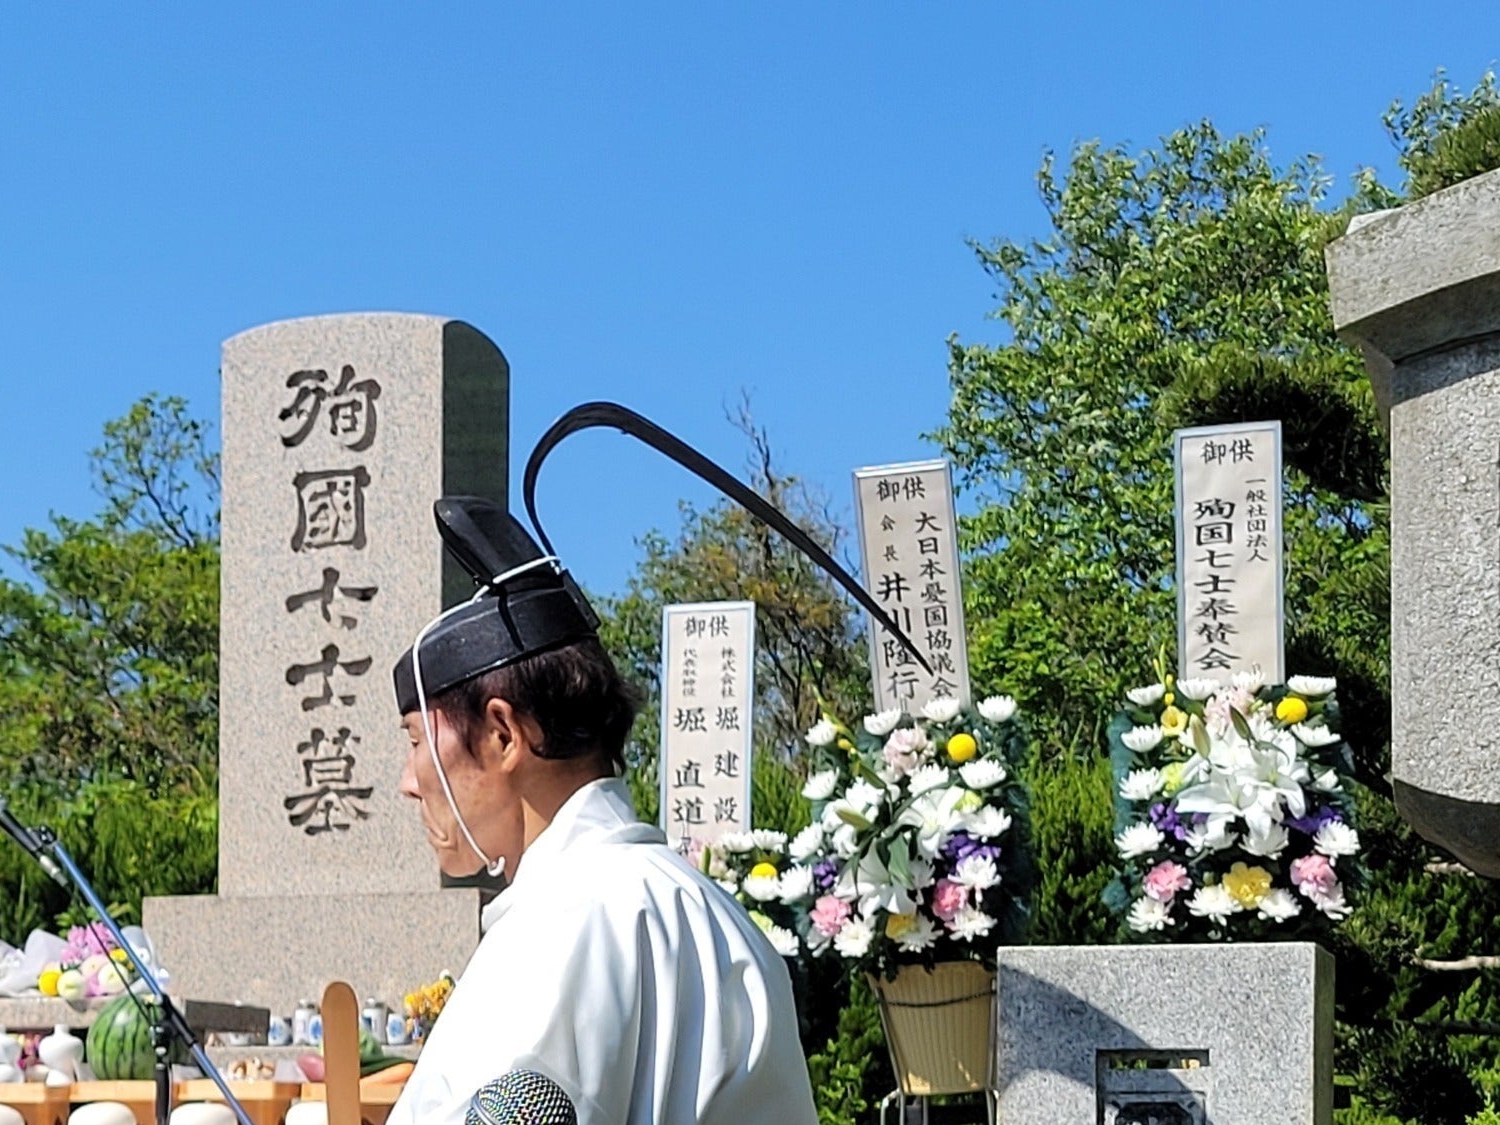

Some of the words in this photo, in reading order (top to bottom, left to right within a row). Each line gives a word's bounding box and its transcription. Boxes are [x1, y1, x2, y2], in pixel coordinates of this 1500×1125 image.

[1200, 438, 1254, 465] 御供
[877, 475, 926, 502] 御供
[880, 513, 900, 562] 会長
[1245, 477, 1269, 562] 一般社団法人
[279, 365, 381, 836] 殉國七士墓
[1193, 497, 1241, 671] 殉国七士奉賛会
[685, 614, 729, 639] 御供
